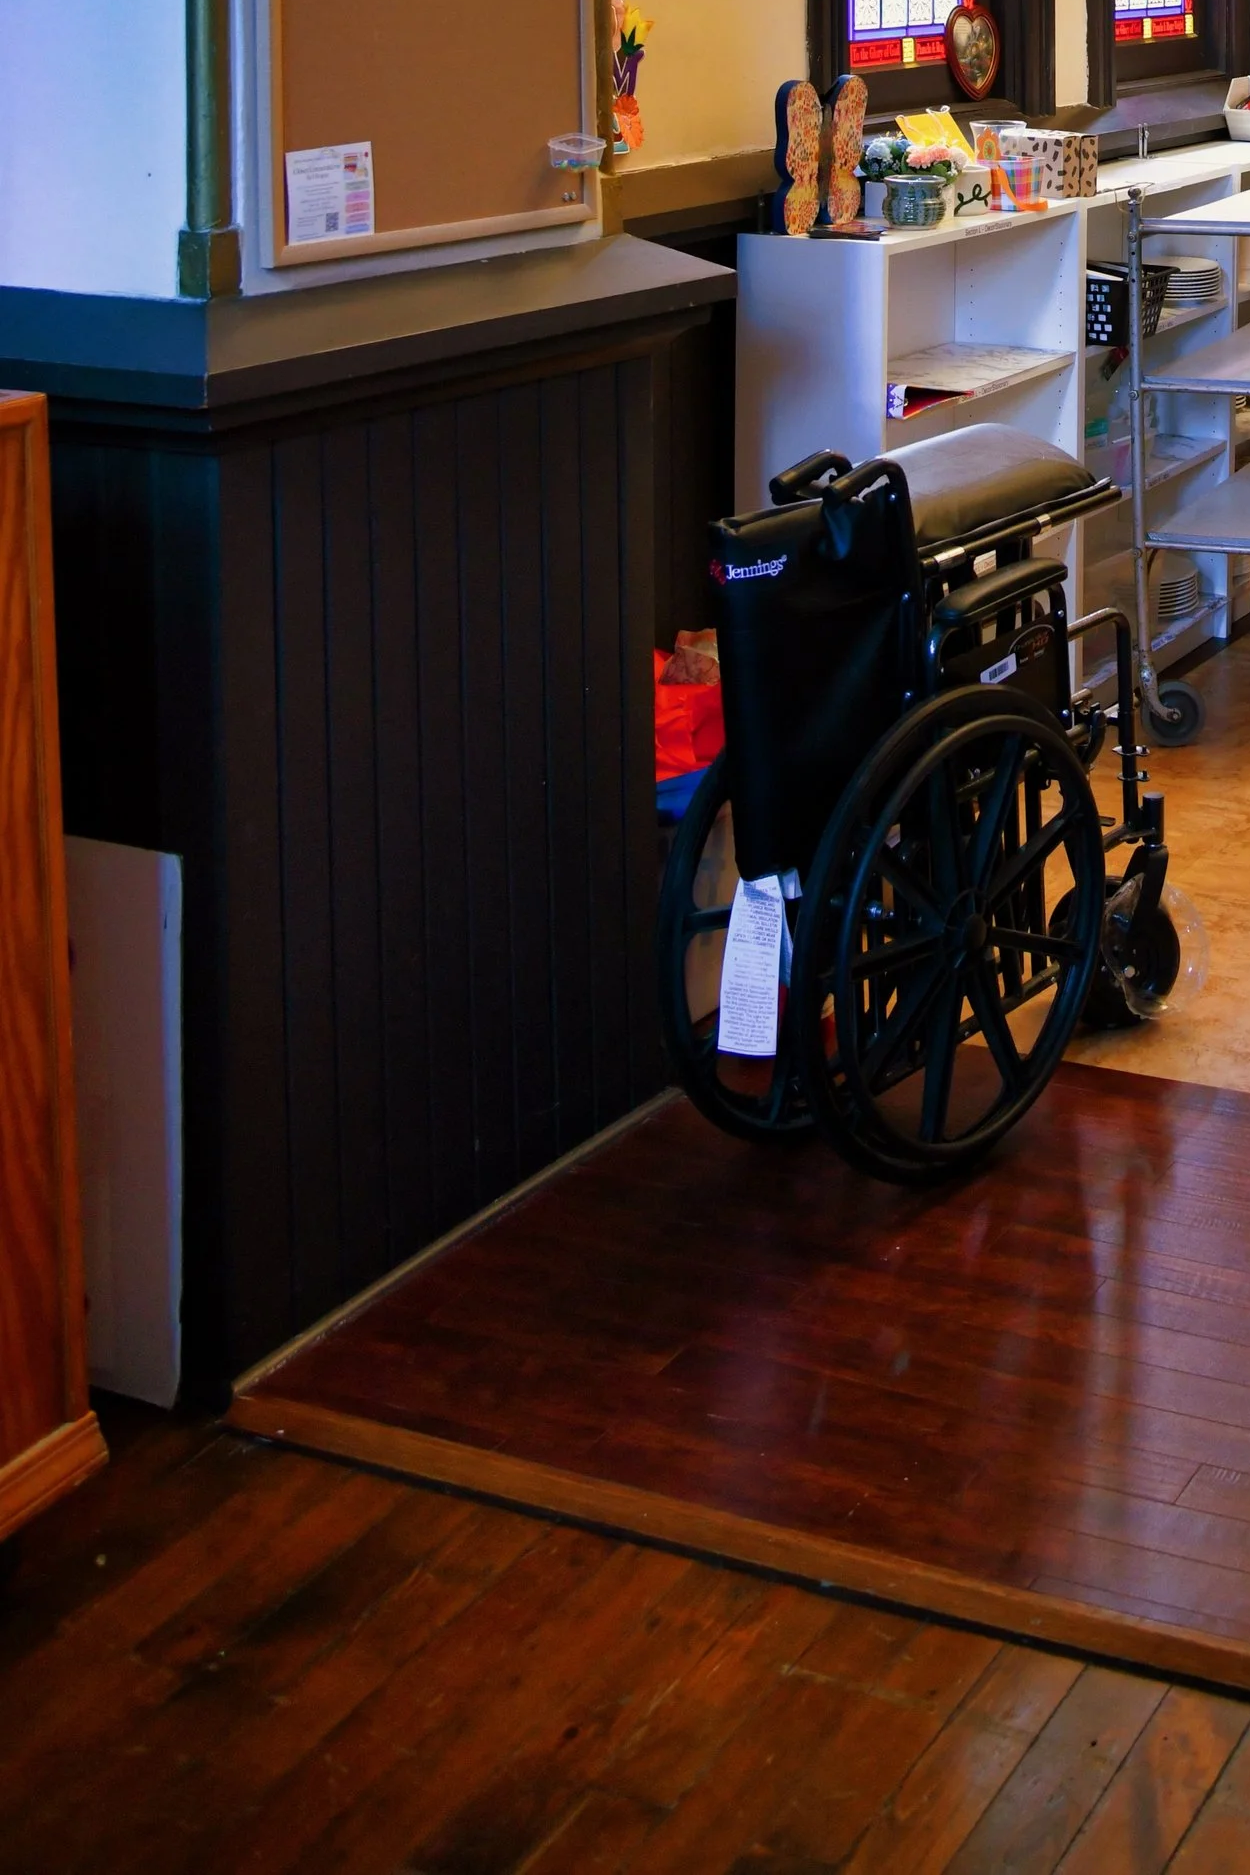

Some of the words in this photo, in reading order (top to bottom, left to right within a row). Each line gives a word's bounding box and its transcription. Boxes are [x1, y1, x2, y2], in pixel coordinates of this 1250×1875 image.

[869, 46, 883, 62] Glory
[889, 43, 900, 57] God
[725, 559, 784, 580] Jennings
